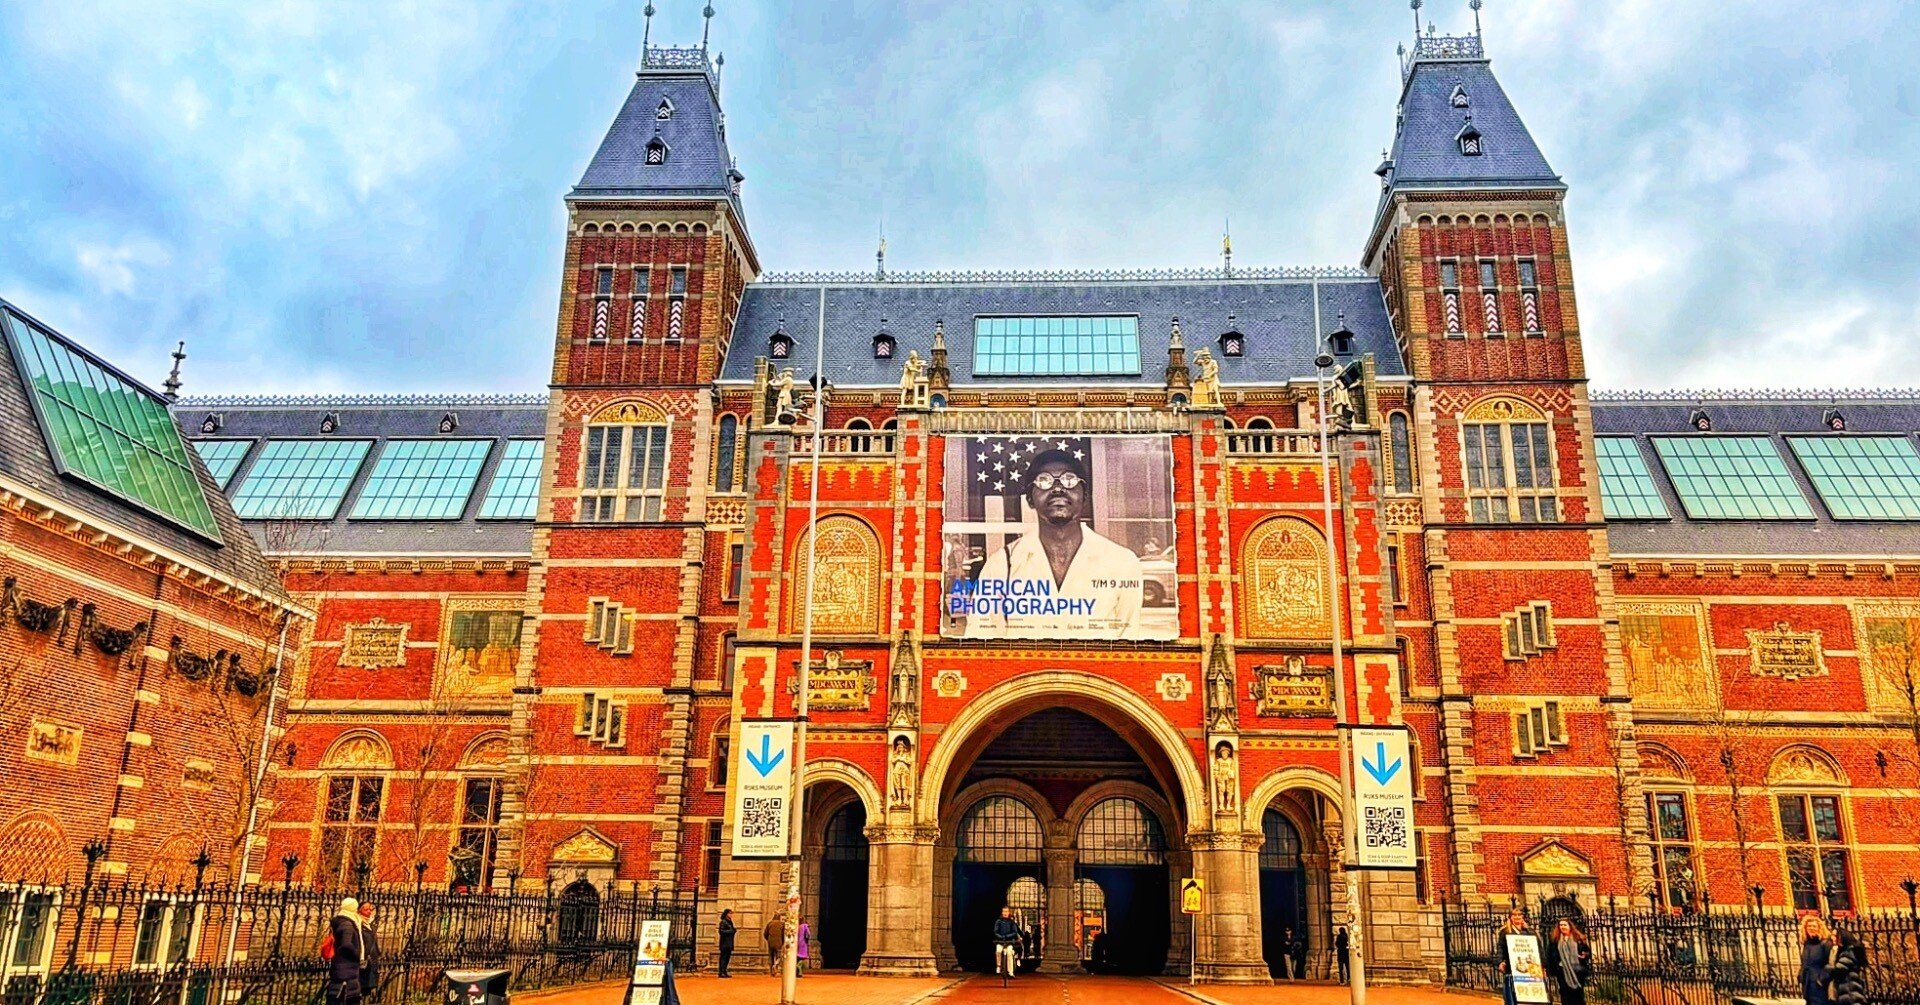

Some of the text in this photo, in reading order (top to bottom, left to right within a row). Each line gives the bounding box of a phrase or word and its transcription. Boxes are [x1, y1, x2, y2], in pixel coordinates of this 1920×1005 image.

[950, 579, 1050, 596] AMERICAN
[1091, 579, 1139, 589] T/M 9 JUNI
[950, 598, 1096, 615] PHOTOGRAPHY
